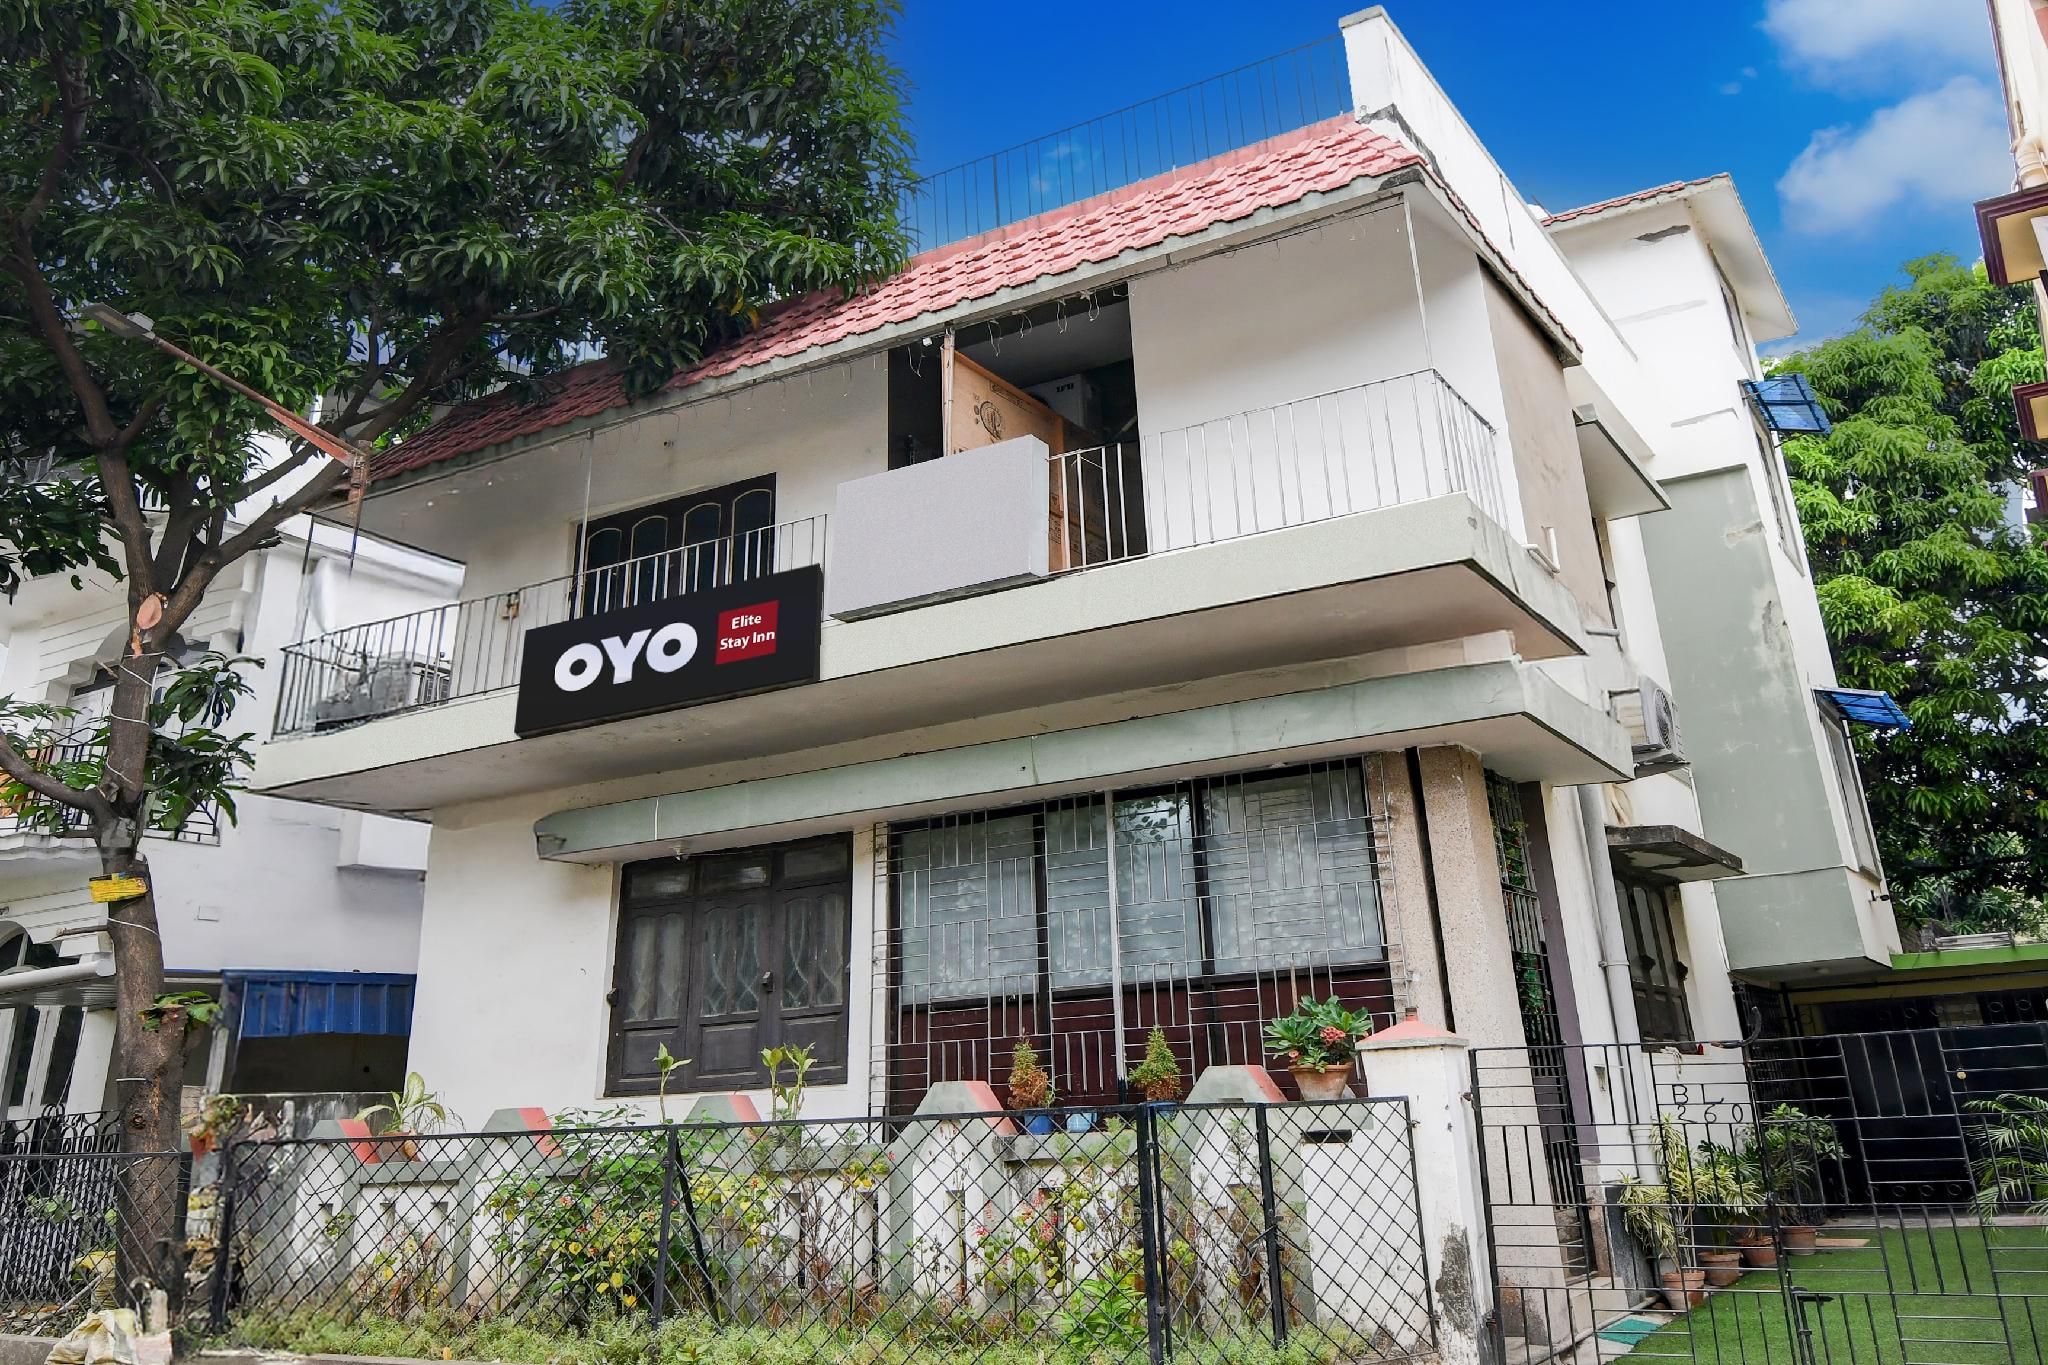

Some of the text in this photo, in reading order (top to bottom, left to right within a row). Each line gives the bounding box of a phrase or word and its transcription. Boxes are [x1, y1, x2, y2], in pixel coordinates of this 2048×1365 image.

[731, 615, 762, 630] Elite
[720, 631, 776, 650] Stay Inn
[554, 622, 698, 692] OYO
[1677, 1104, 1743, 1123] 260
